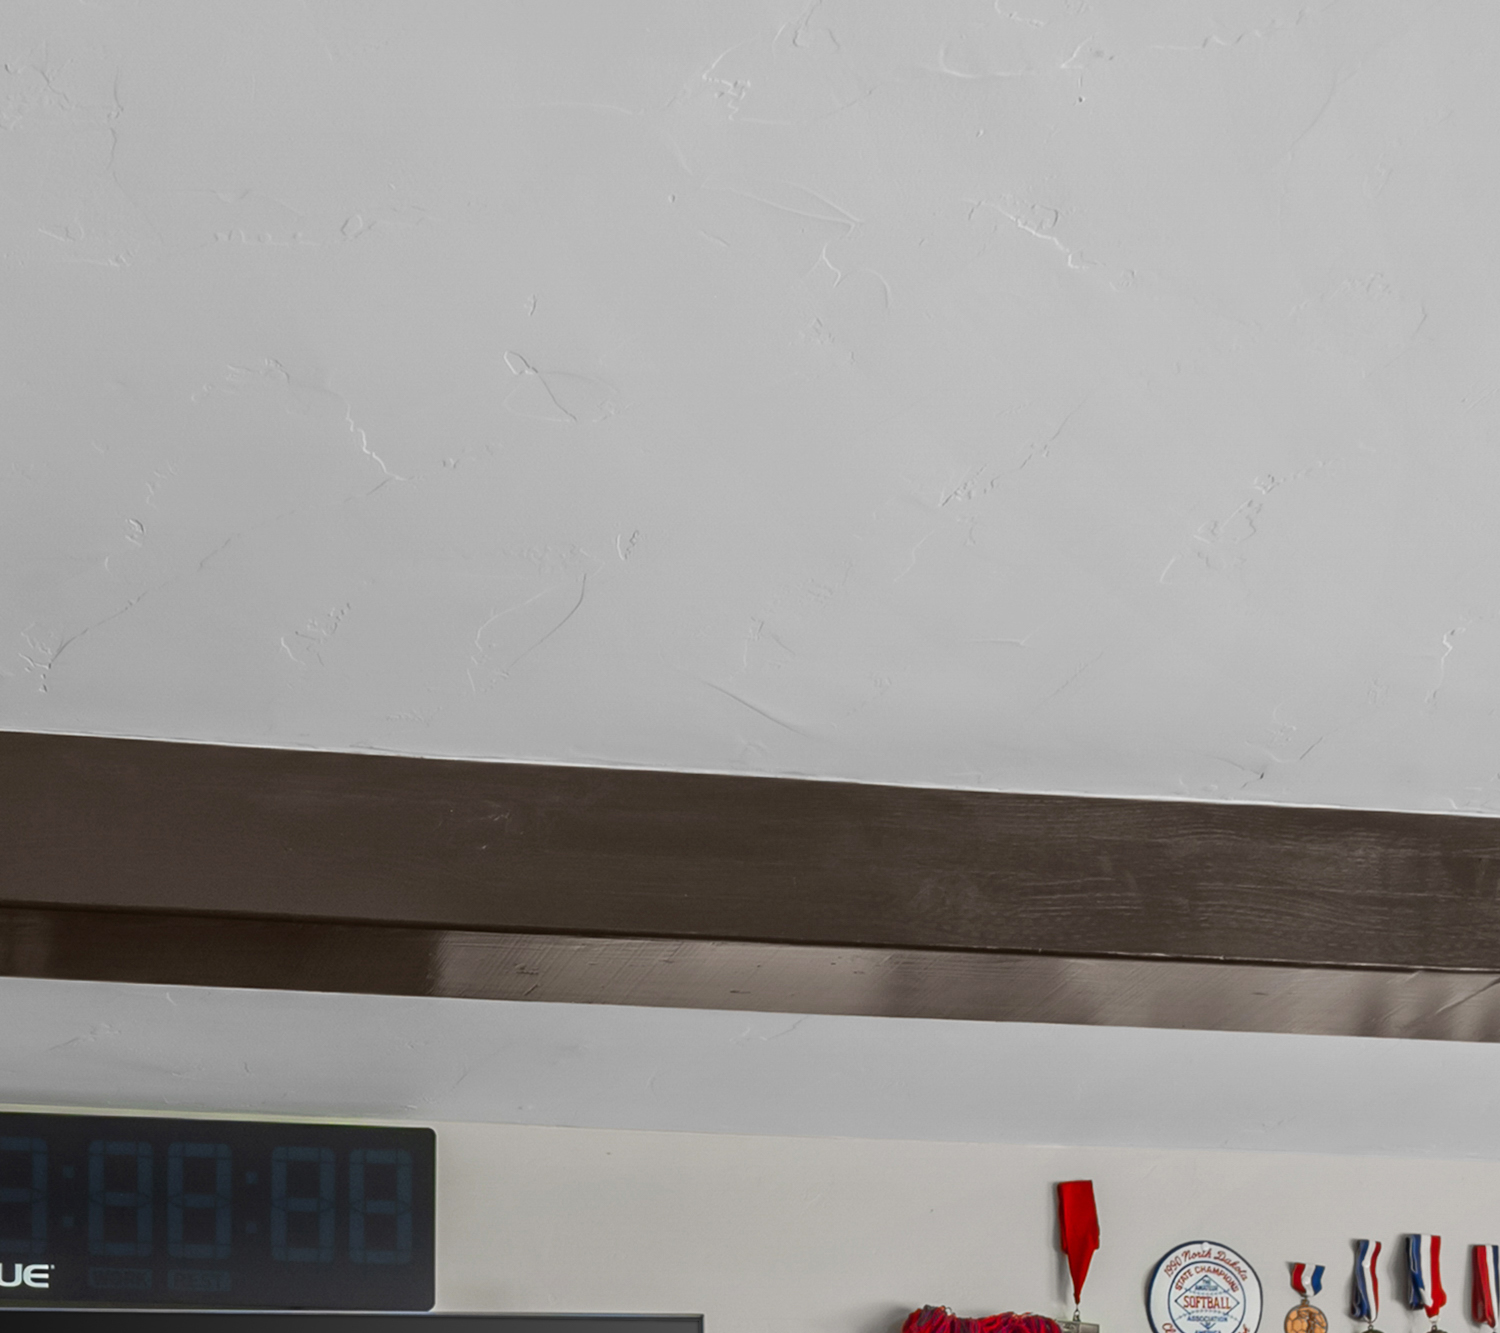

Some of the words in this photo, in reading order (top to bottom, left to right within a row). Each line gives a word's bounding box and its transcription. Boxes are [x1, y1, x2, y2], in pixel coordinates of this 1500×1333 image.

[1164, 1256, 1182, 1277] 1990
[1182, 1249, 1212, 1262] North
[1175, 1269, 1193, 1291] STATE
[1184, 1296, 1231, 1309] SOFTBALL
